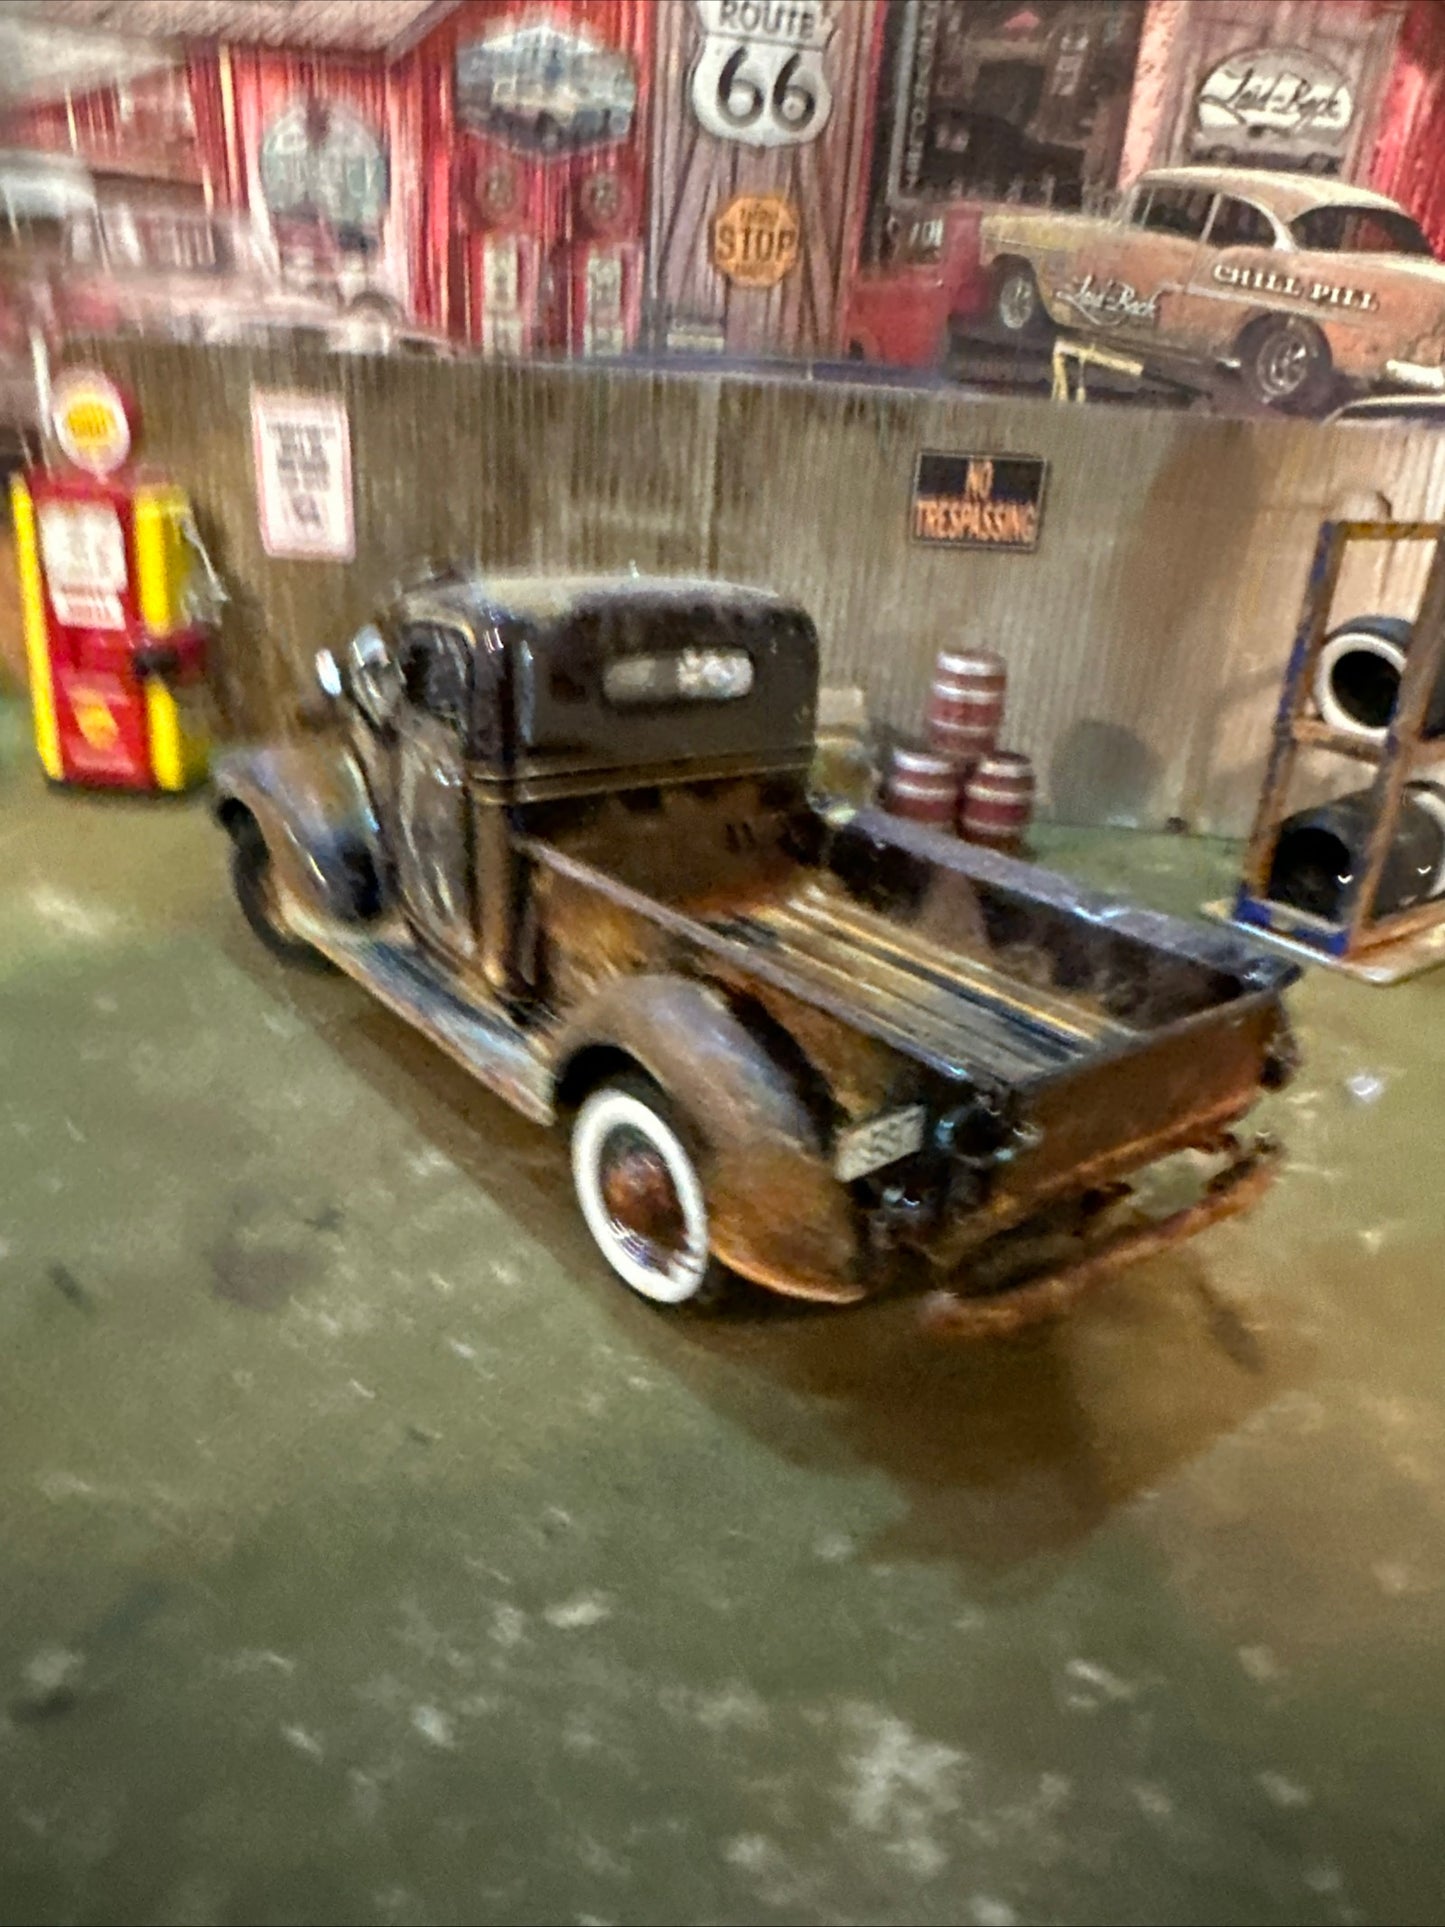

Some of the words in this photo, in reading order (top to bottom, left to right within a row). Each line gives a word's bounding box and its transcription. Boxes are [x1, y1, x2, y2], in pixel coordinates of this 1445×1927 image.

[720, 0, 815, 39] ROUTE
[717, 46, 816, 131] 66
[717, 224, 797, 261] STOP
[1213, 264, 1302, 297] CHILL
[1310, 282, 1379, 312] PILL
